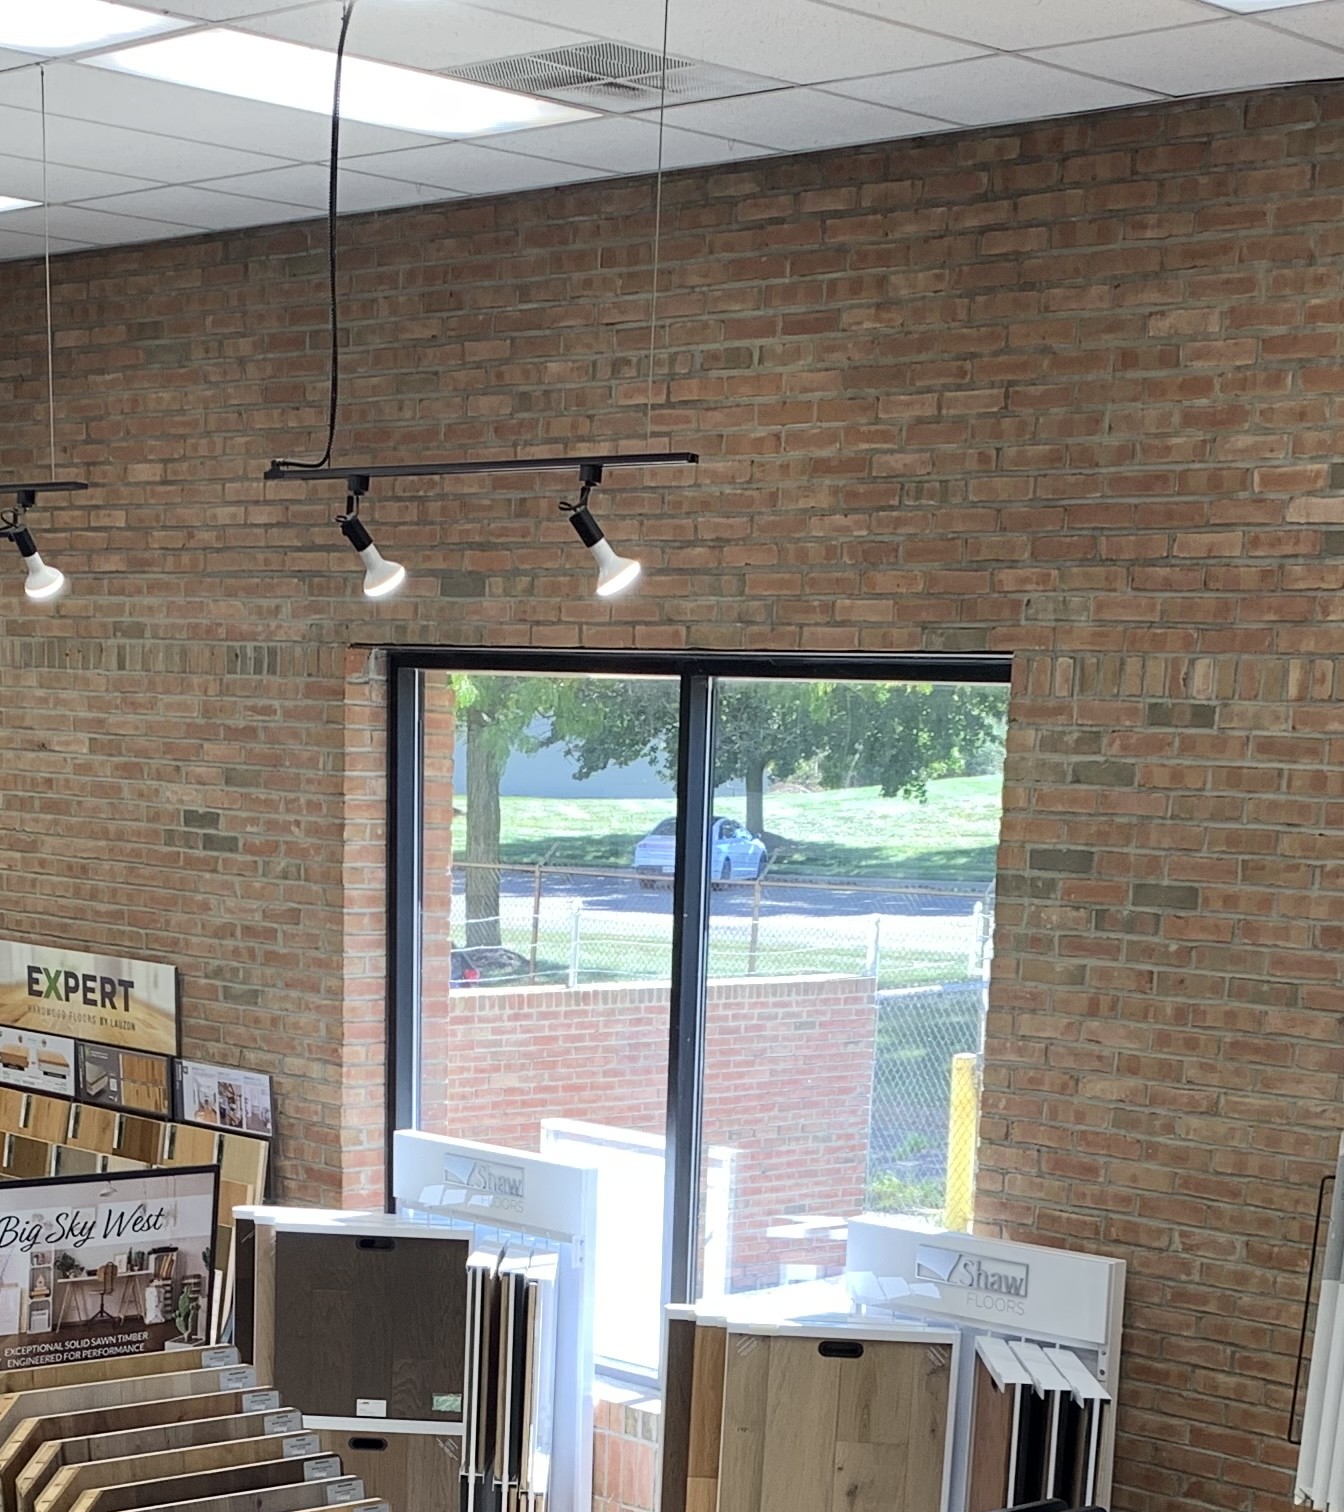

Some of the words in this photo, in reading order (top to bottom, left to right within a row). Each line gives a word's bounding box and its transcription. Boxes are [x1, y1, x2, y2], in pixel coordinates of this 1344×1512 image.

[27, 965, 134, 1012] EXPERT
[68, 1011, 96, 1025] FLOORS
[100, 1016, 109, 1026] BY
[109, 1018, 136, 1031] LAUZON
[476, 1165, 523, 1198] Shaw
[45, 1210, 97, 1248] Sky
[102, 1204, 164, 1240] West
[958, 1259, 1024, 1296] Shaw
[966, 1292, 1025, 1316] FLOORS
[4, 1340, 64, 1357] EXCEPTIONAL
[64, 1337, 90, 1349] SOLID
[91, 1334, 116, 1347] SAWN
[117, 1331, 149, 1343] TIMBER
[7, 1351, 63, 1368] ENGINEERED
[63, 1349, 81, 1361] FOR
[82, 1343, 145, 1359] PERFORMANCE
